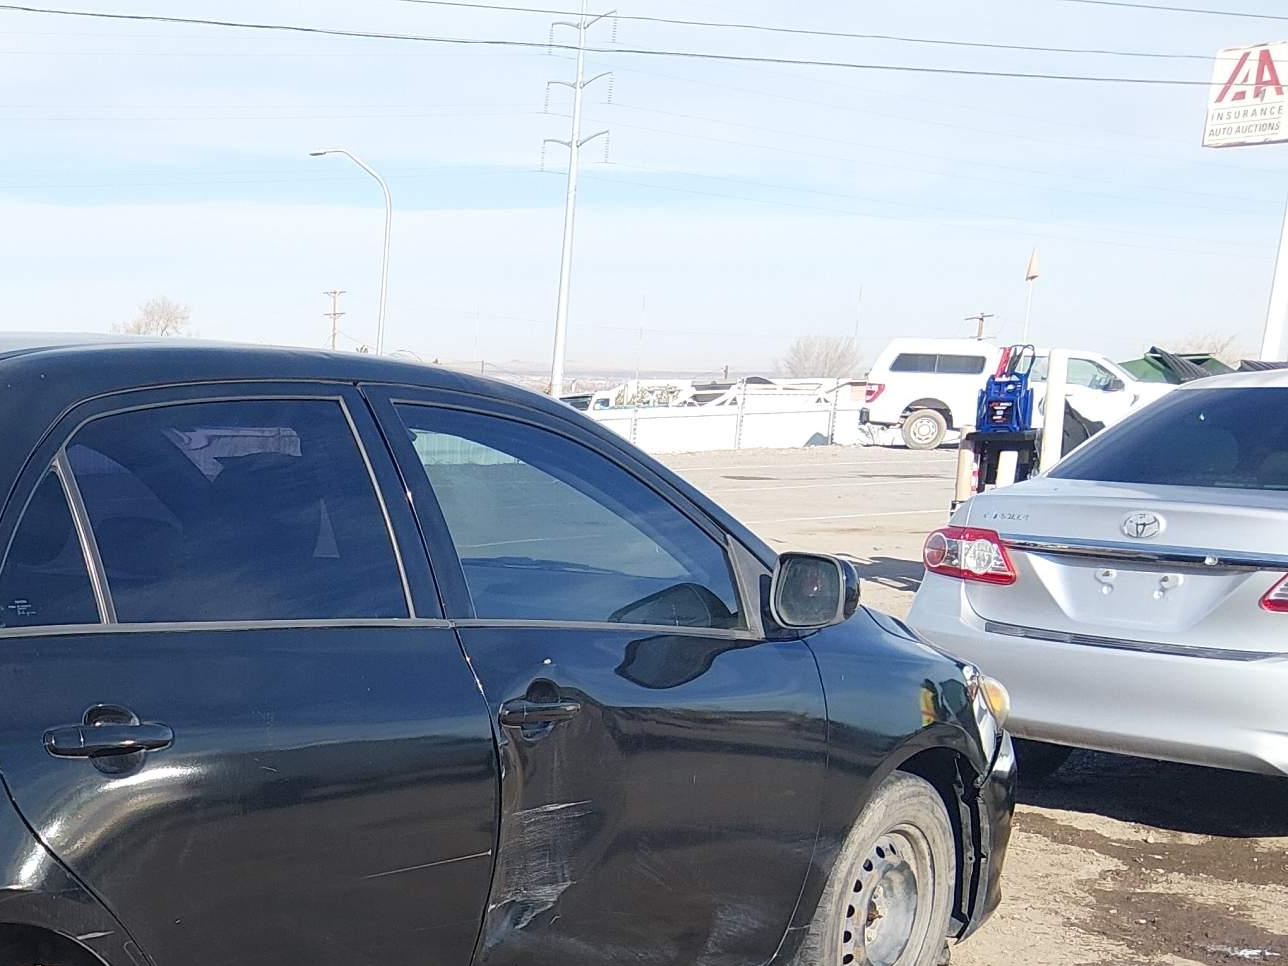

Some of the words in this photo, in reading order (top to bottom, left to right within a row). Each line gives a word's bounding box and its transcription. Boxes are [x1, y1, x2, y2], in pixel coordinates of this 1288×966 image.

[1210, 105, 1284, 121] INSURANCE
[1208, 127, 1233, 138] AUTO
[1234, 121, 1281, 135] AUCTIONS
